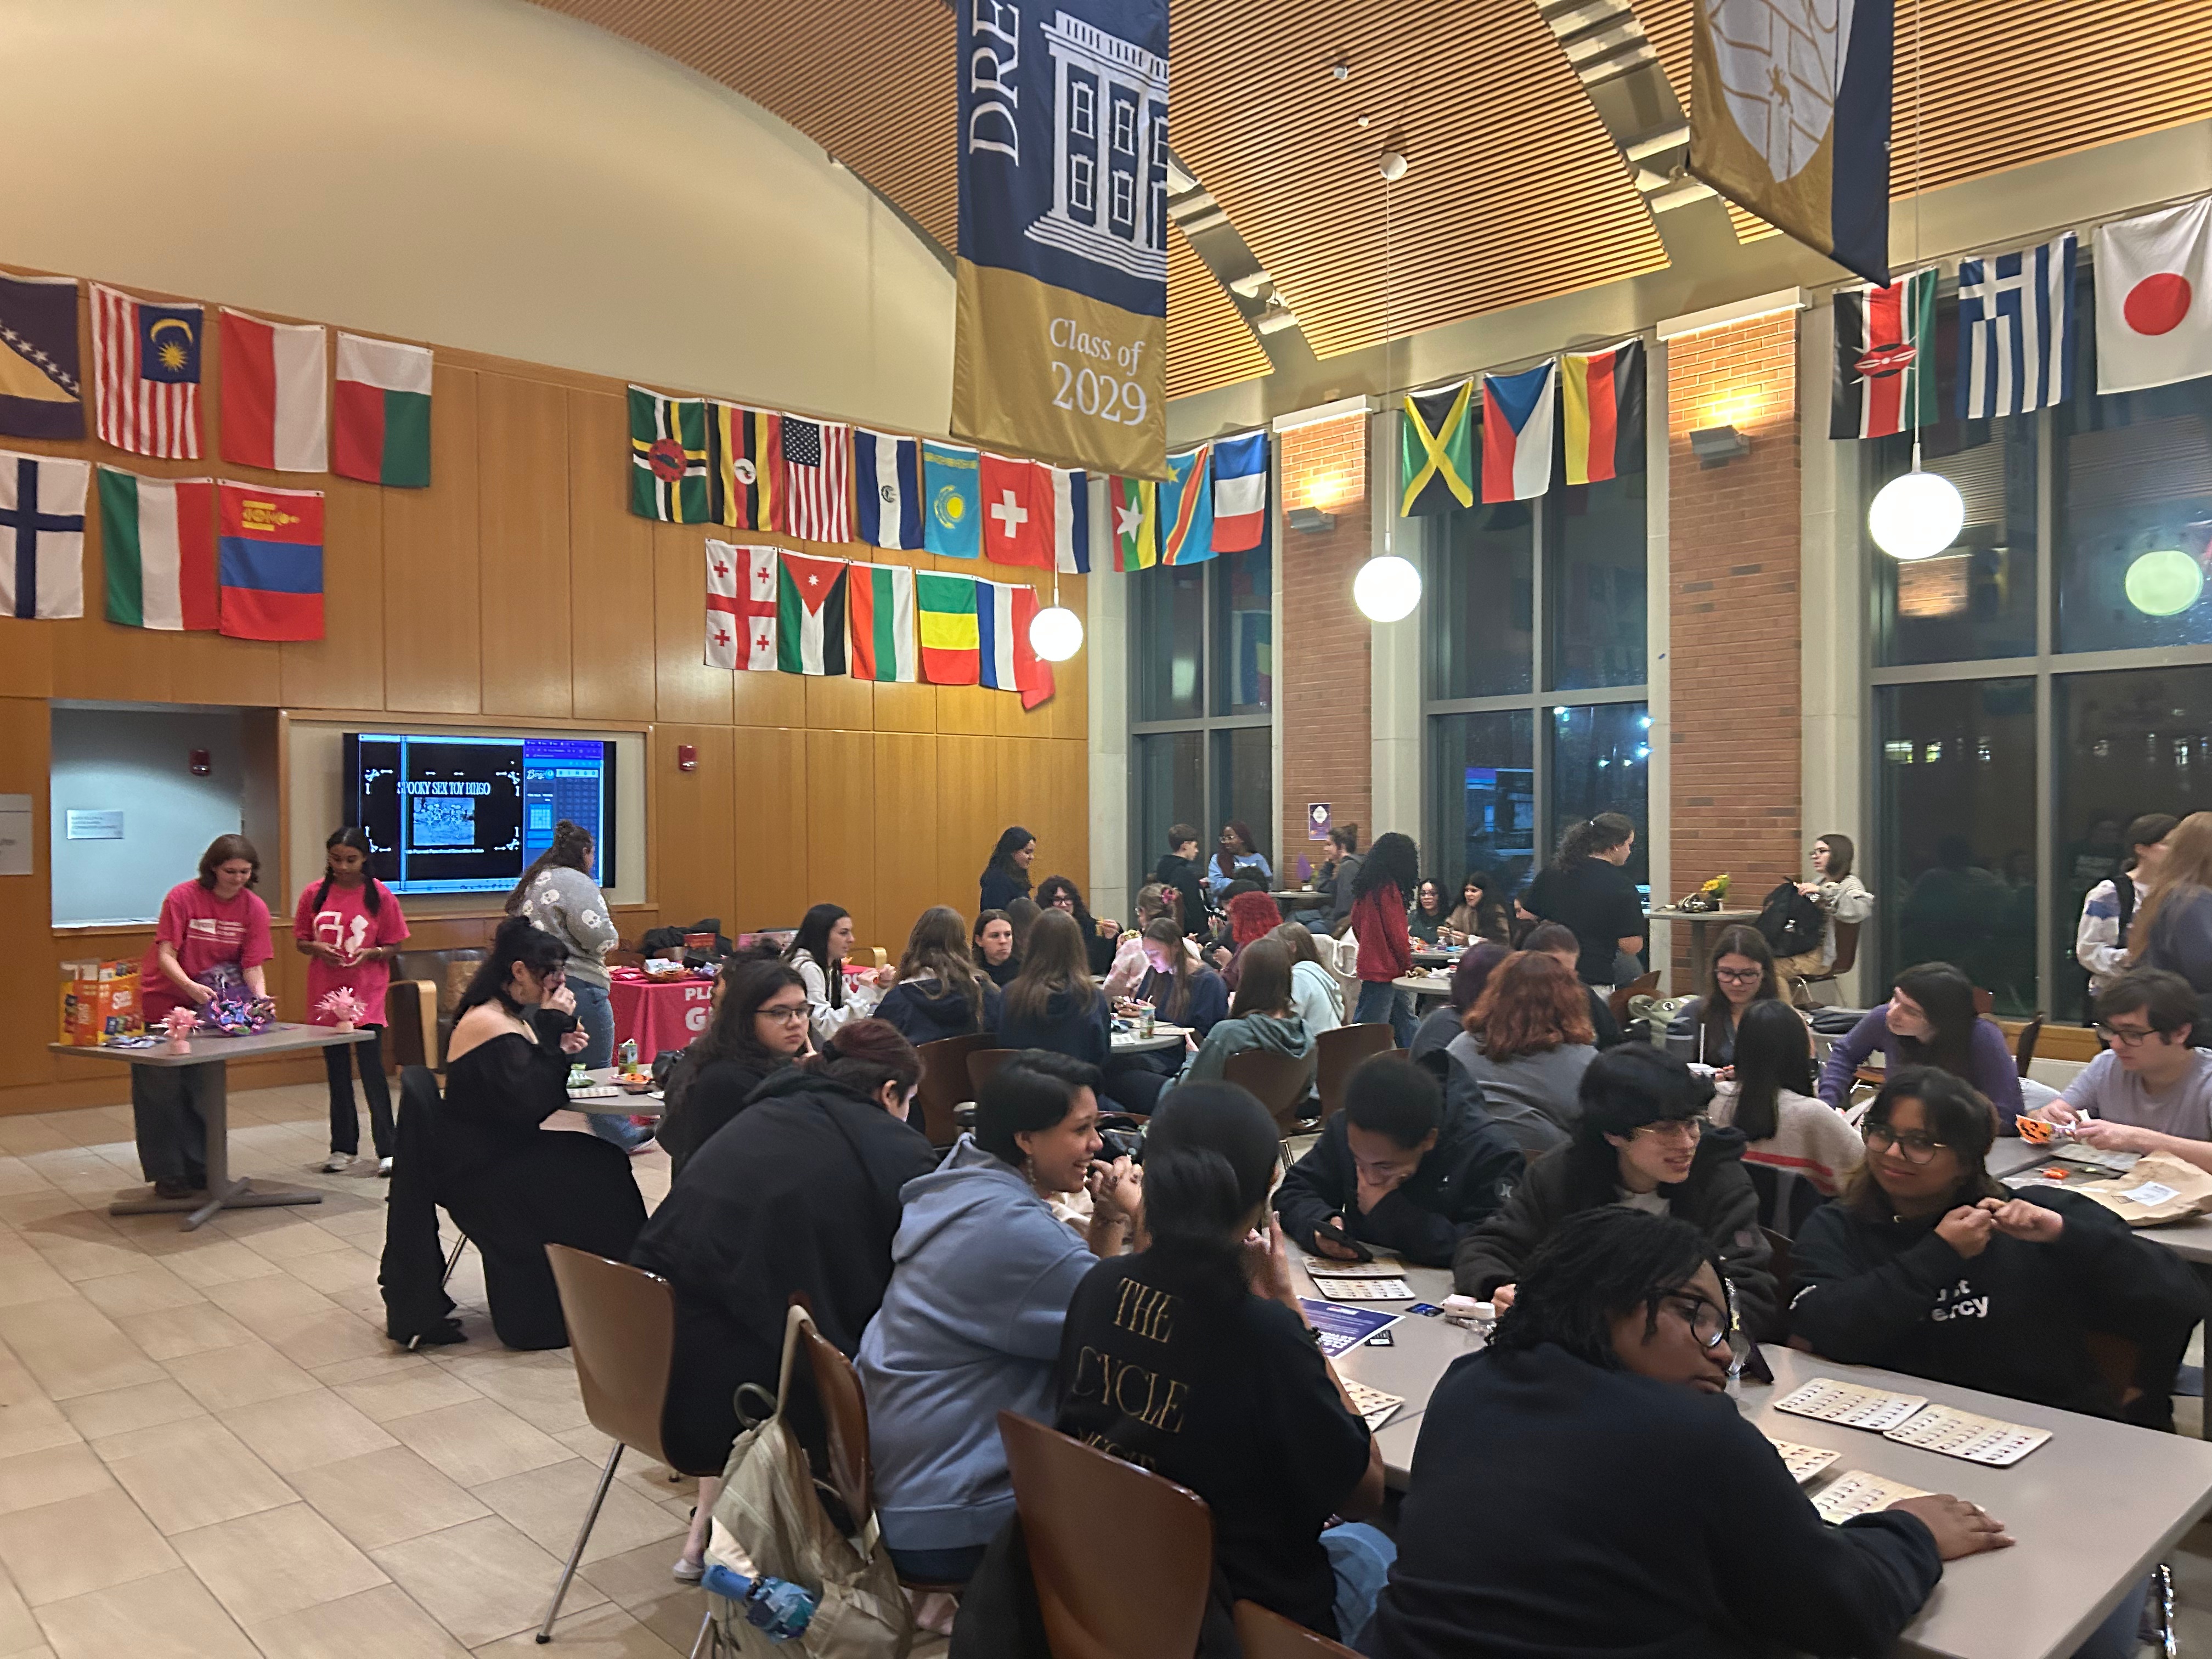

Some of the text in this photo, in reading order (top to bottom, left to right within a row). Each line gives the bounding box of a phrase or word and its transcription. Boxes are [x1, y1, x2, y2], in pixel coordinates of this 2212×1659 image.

[1050, 317, 1146, 376] Class of
[1052, 360, 1147, 426] 2029
[431, 781, 448, 795] SEX
[449, 781, 465, 795] TOY
[465, 782, 491, 795] BINGO
[1113, 1277, 1184, 1344] THE
[1073, 1346, 1189, 1434] CYCLE
